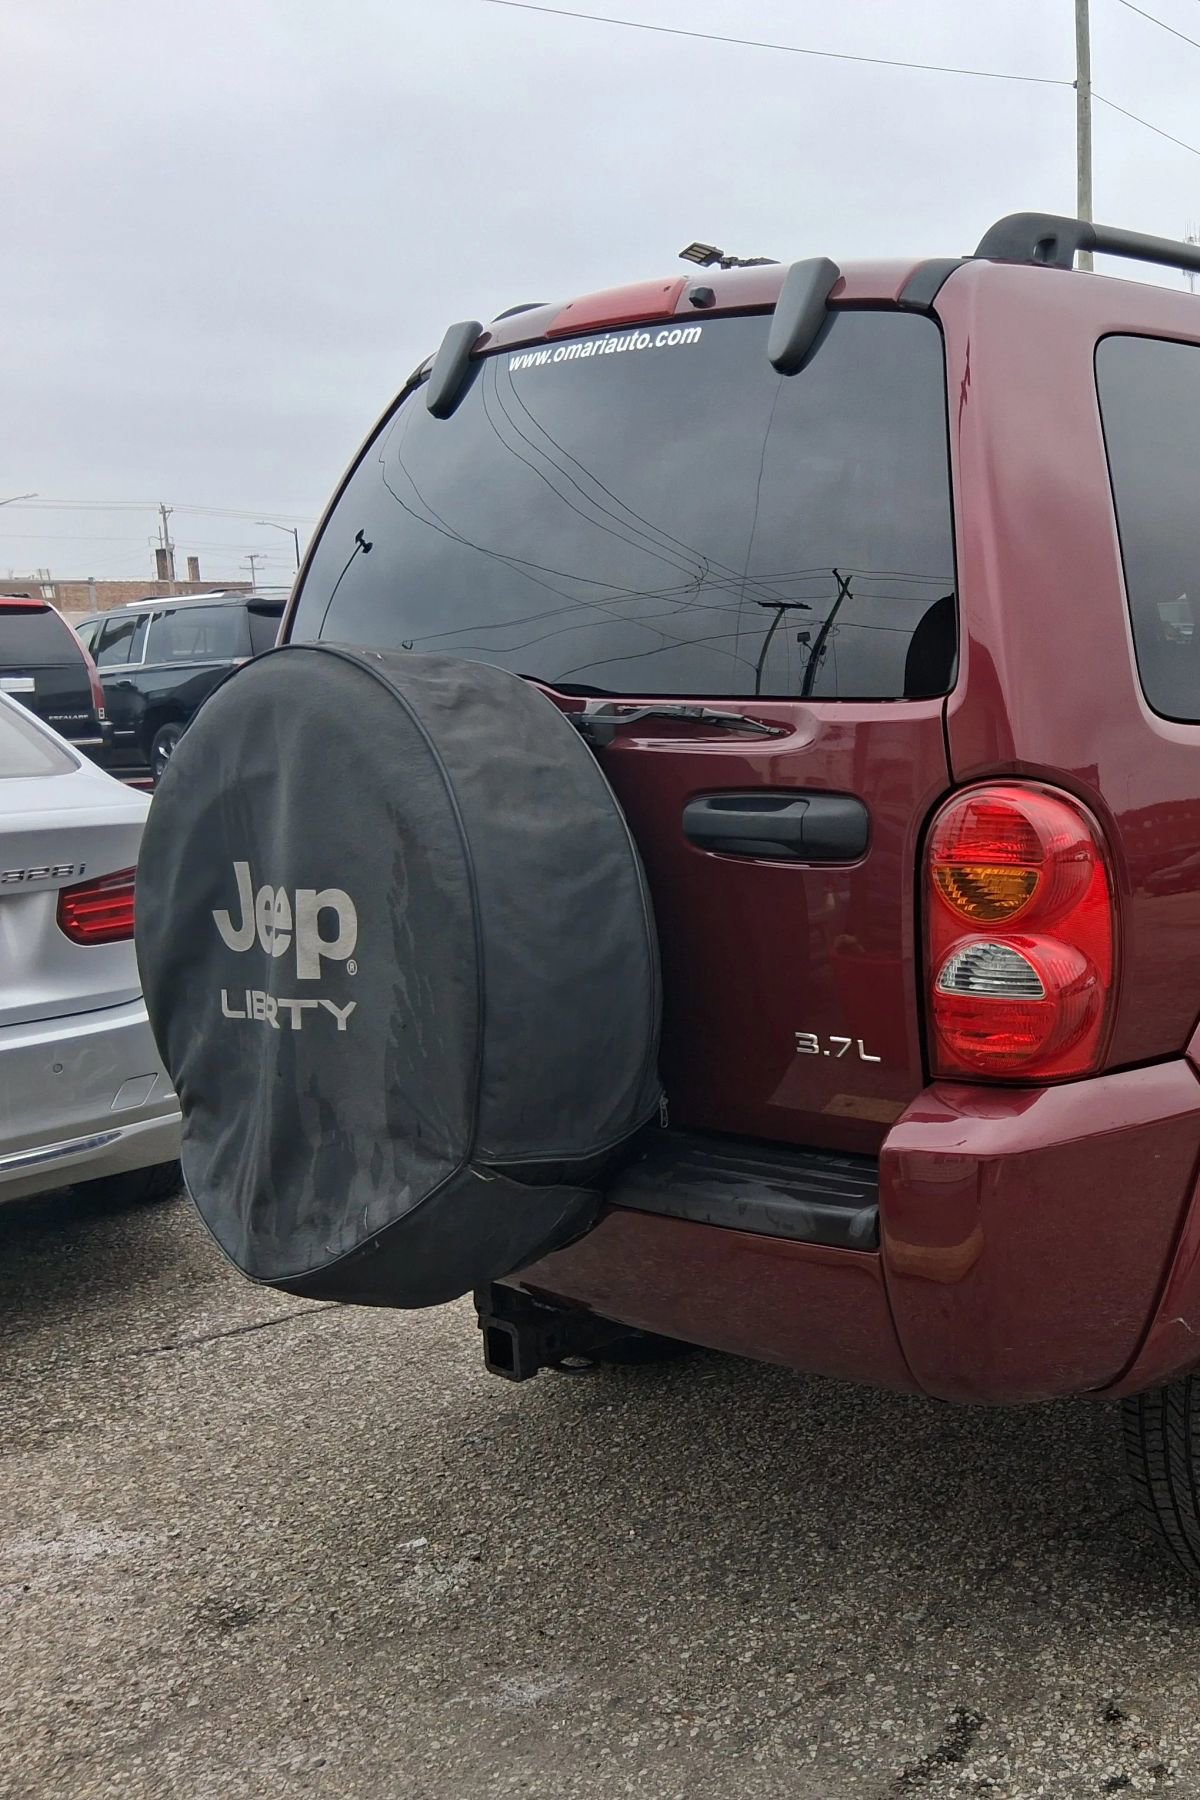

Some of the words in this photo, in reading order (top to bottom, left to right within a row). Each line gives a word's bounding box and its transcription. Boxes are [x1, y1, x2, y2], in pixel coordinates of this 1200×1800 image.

[508, 326, 702, 371] www.omariauto.com
[1, 861, 87, 884] 328i
[212, 861, 358, 979] Jeep
[795, 1031, 881, 1062] 3.7L
